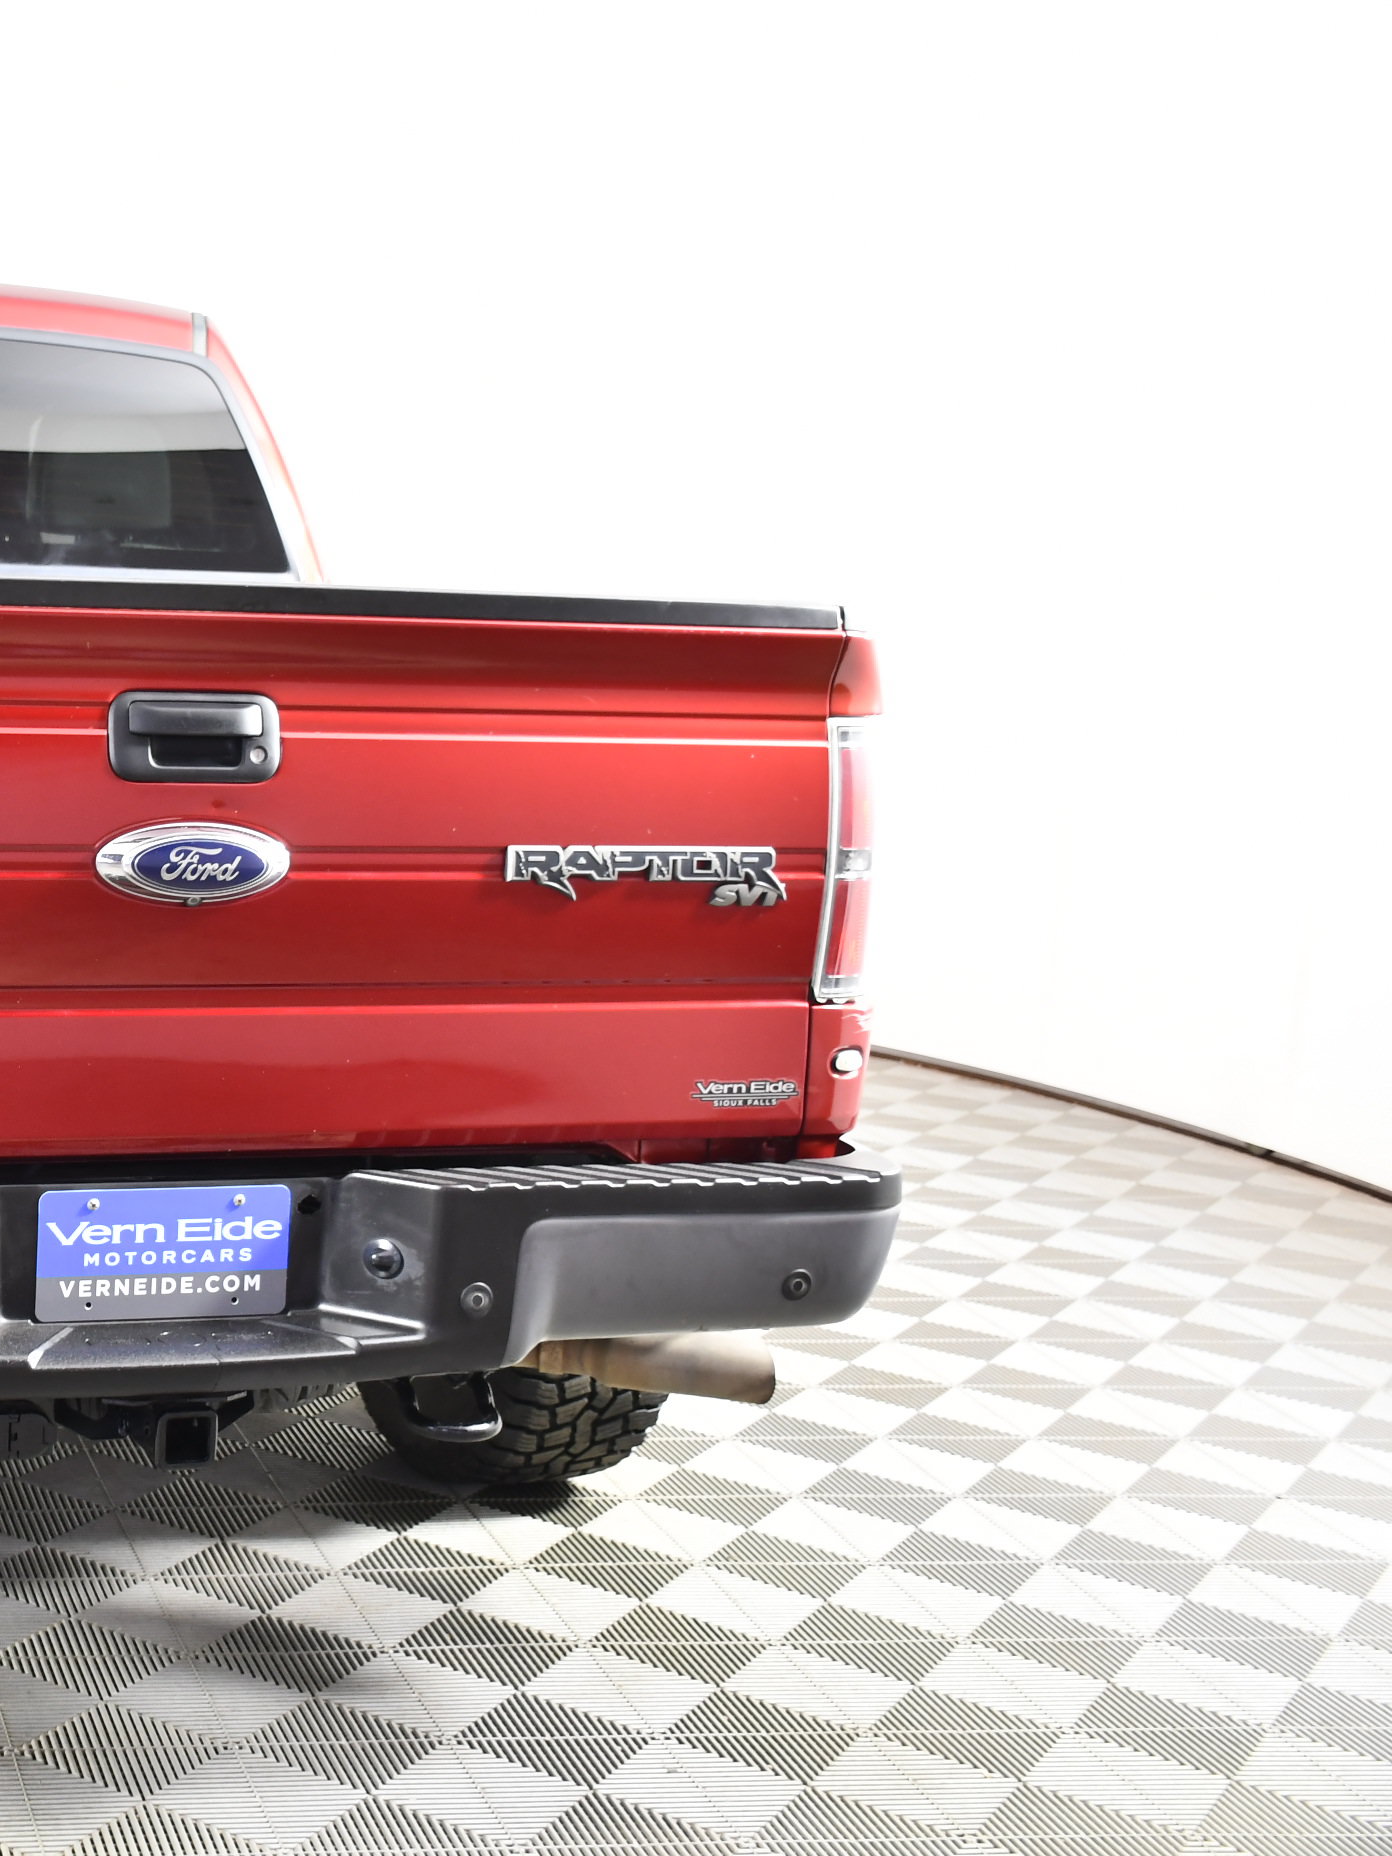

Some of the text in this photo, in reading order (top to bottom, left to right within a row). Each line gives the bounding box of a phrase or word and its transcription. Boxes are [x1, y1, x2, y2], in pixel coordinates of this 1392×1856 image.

[160, 846, 242, 882] Ford
[505, 844, 787, 901] RAPTOR
[709, 883, 780, 906] SVT
[696, 1080, 796, 1095] Vern Eide
[713, 1099, 778, 1108] SIOUX FALLS
[45, 1216, 283, 1246] Vern Eide
[83, 1247, 253, 1267] MOTORCARS
[59, 1274, 261, 1298] VERNEIDE.COM
